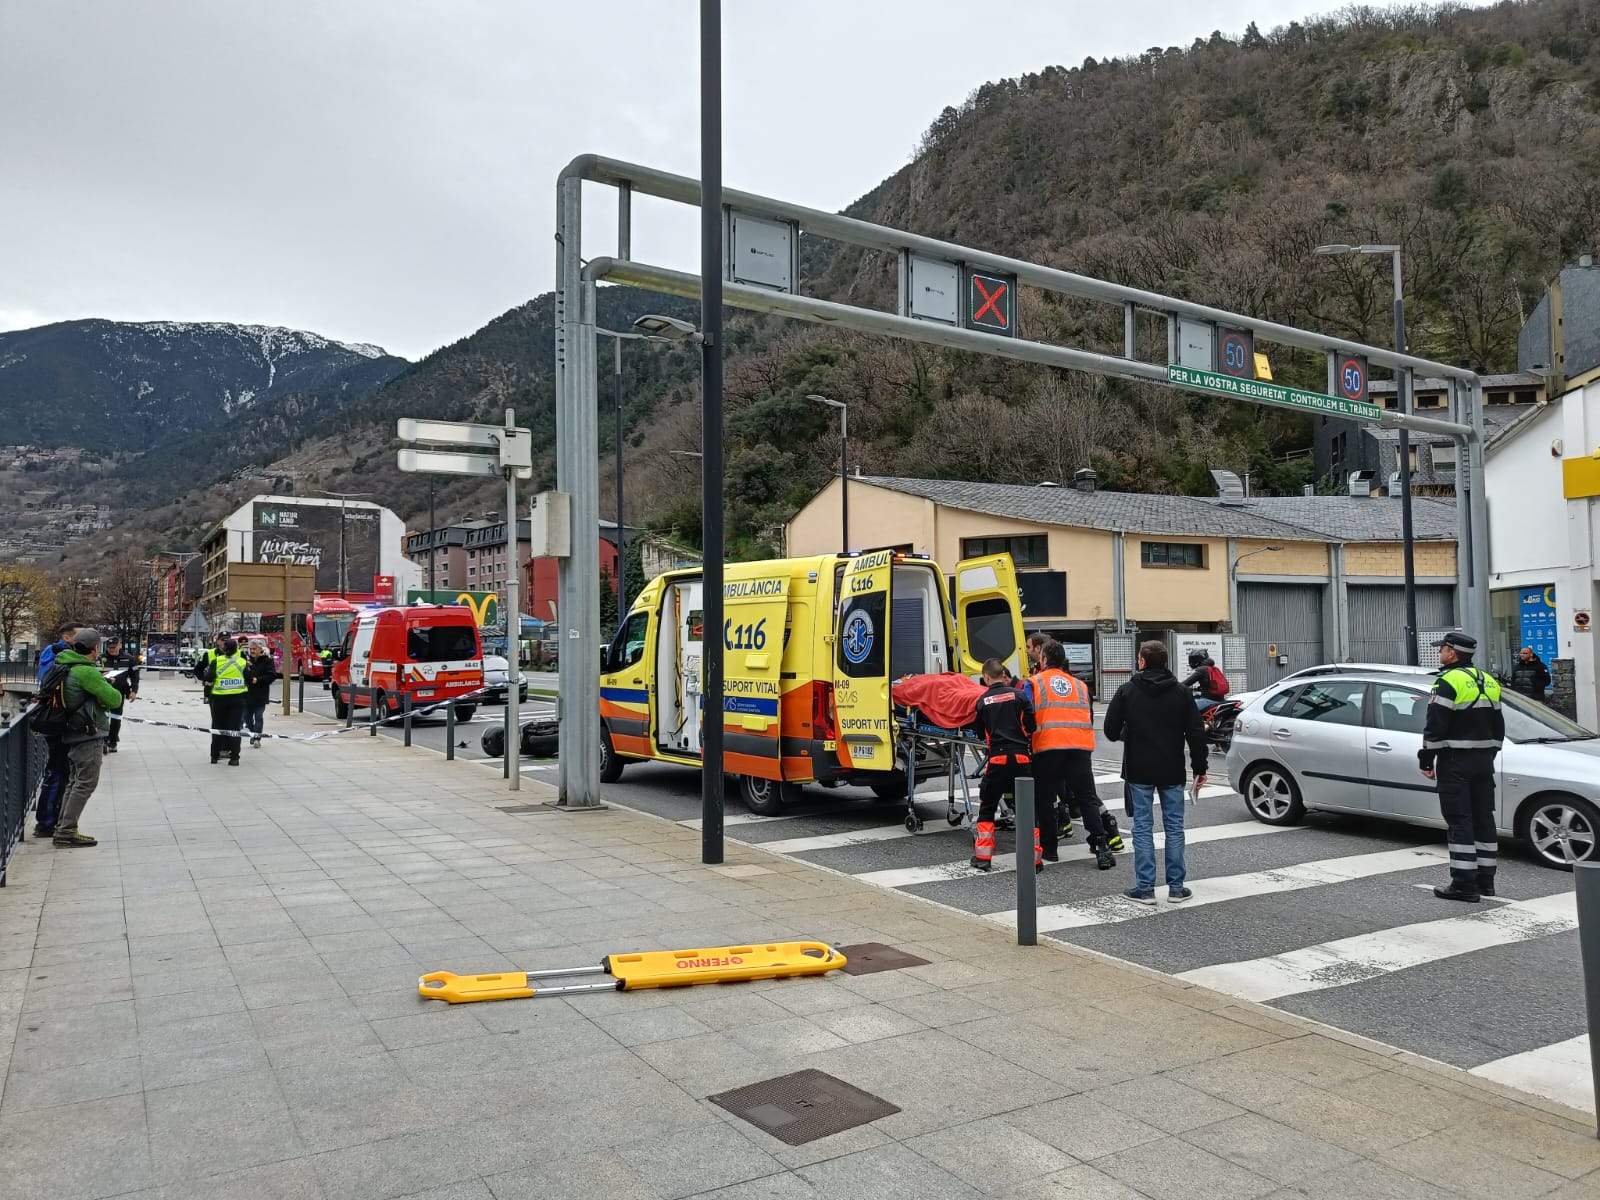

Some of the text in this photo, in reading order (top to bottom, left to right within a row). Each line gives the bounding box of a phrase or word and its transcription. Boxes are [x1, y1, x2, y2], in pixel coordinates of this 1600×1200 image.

[1226, 342, 1244, 369] 50
[1344, 368, 1360, 391] 50
[1170, 368, 1188, 382] PER
[1190, 372, 1202, 385] LA
[1203, 375, 1238, 391] VOSTRA
[1239, 382, 1287, 400] SEGURETAT
[1290, 392, 1338, 410] CONTROLEM
[1340, 402, 1349, 412] EL
[724, 579, 782, 597] MBULÀNCIA
[856, 574, 873, 592] 116
[734, 617, 767, 650] 116
[723, 680, 778, 694] SUPORT VITAL
[841, 718, 888, 730] SUPORT VIT
[676, 957, 730, 969] FERNO
